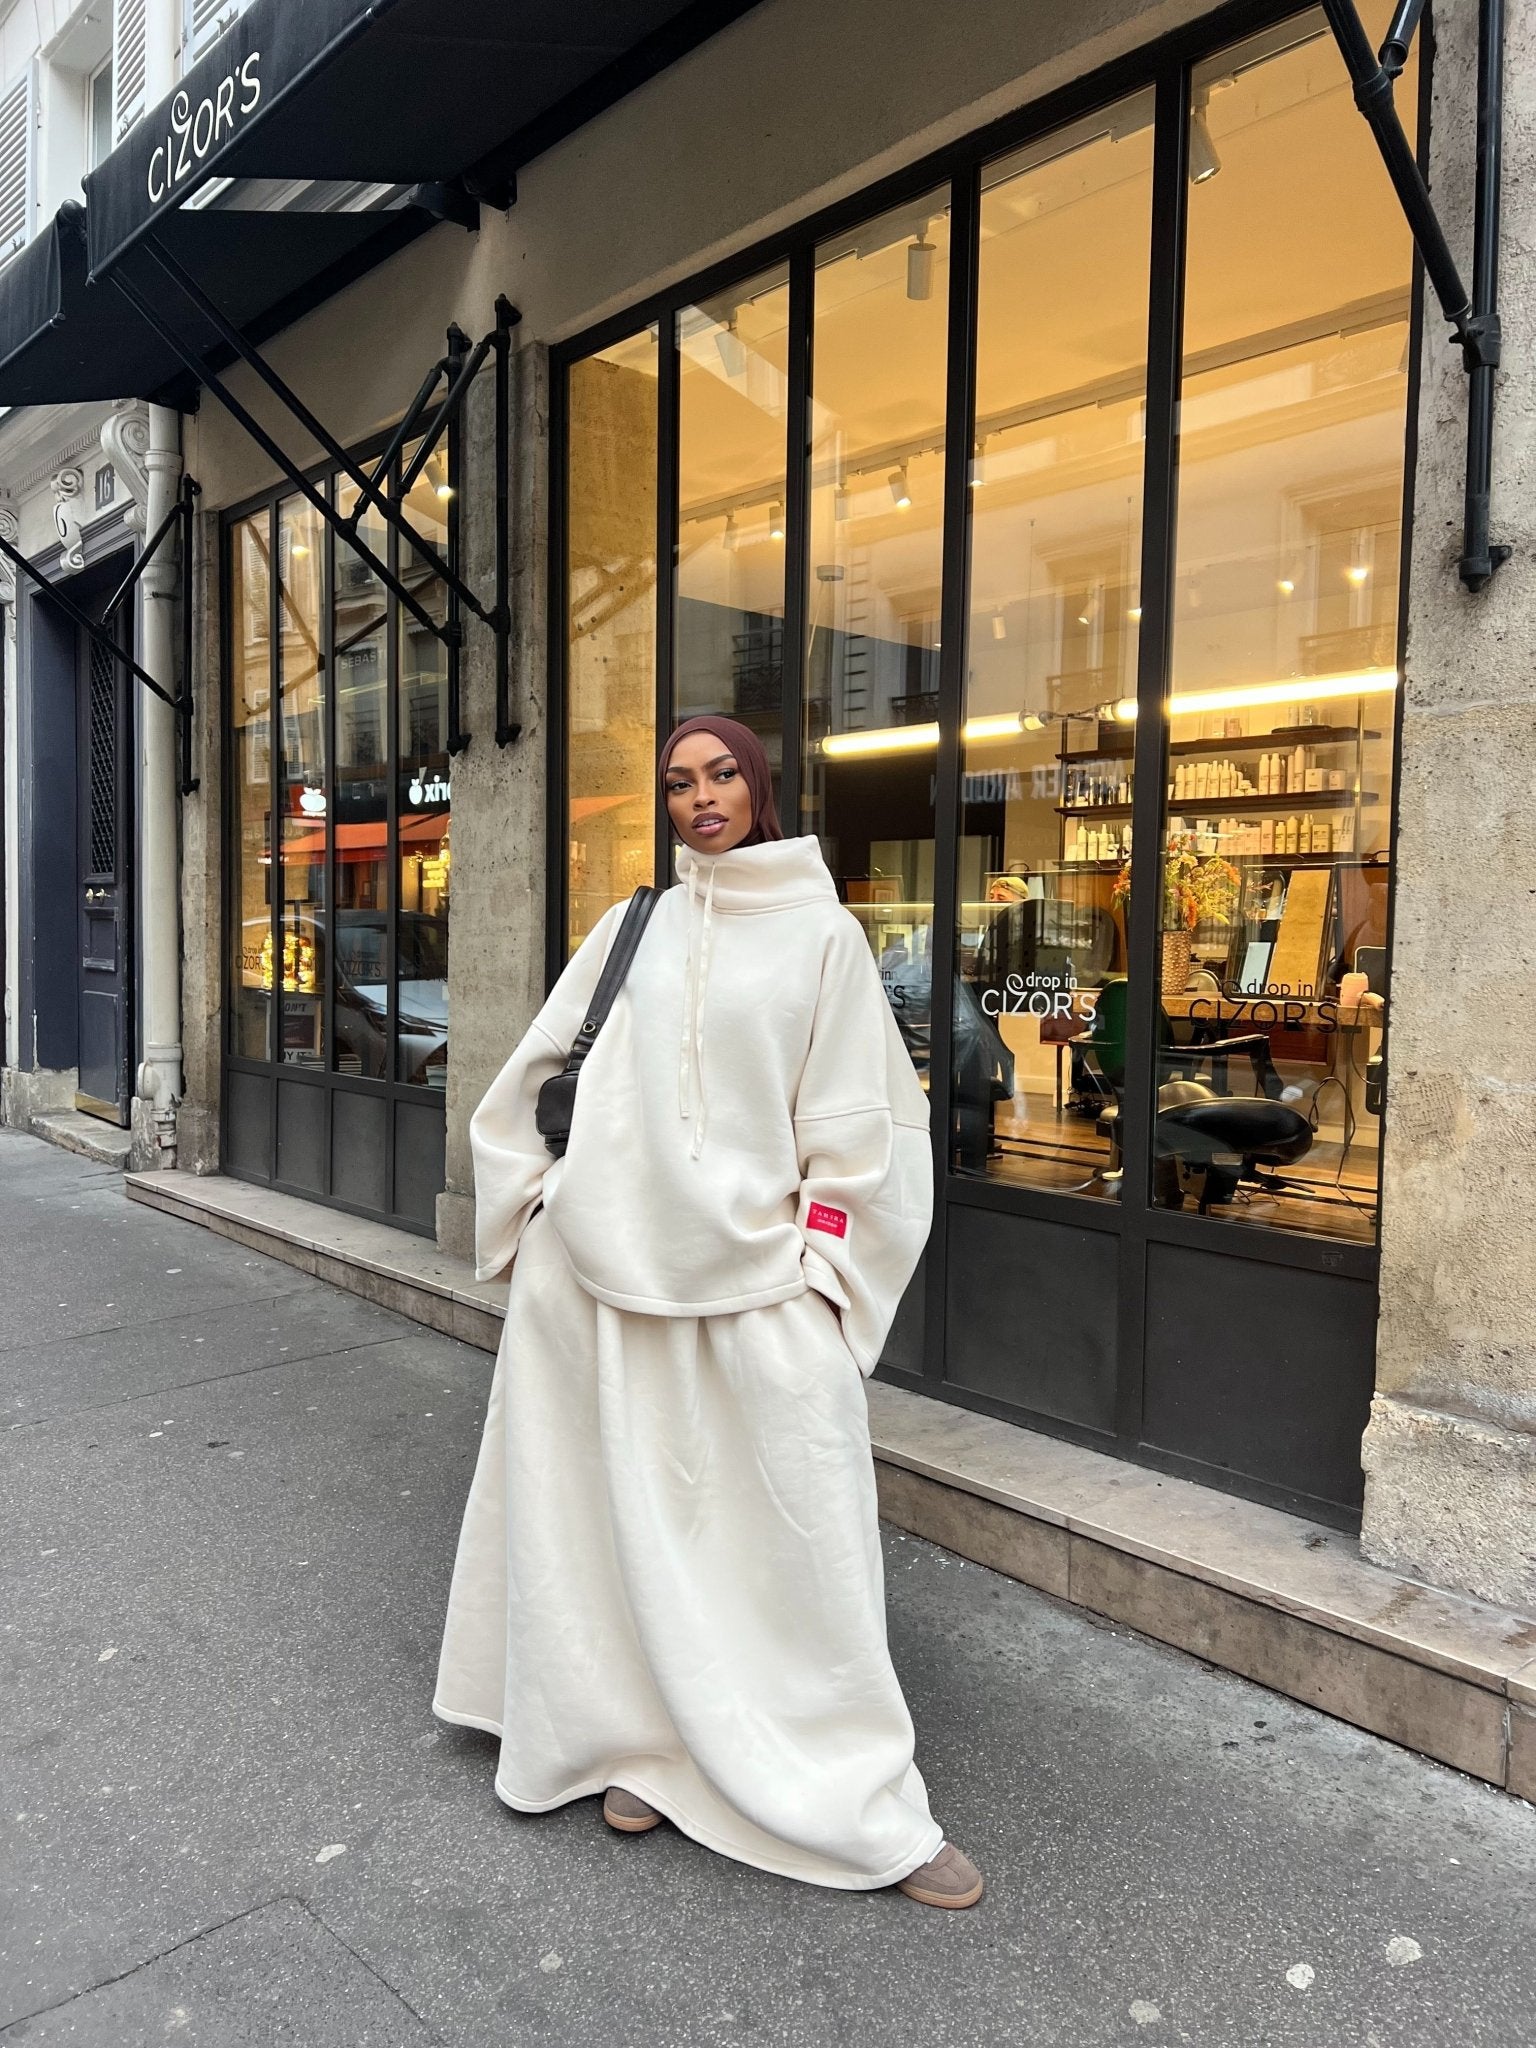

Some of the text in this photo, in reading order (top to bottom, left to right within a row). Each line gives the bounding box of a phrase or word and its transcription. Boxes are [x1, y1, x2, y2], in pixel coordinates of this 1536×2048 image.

[148, 52, 261, 203] CIZOR'S
[100, 469, 111, 503] 16
[981, 974, 1098, 1021] CIZOR'S
[1025, 972, 1078, 991] drop in
[1246, 979, 1313, 998] drop in
[1189, 981, 1338, 1034] CIZOR'S
